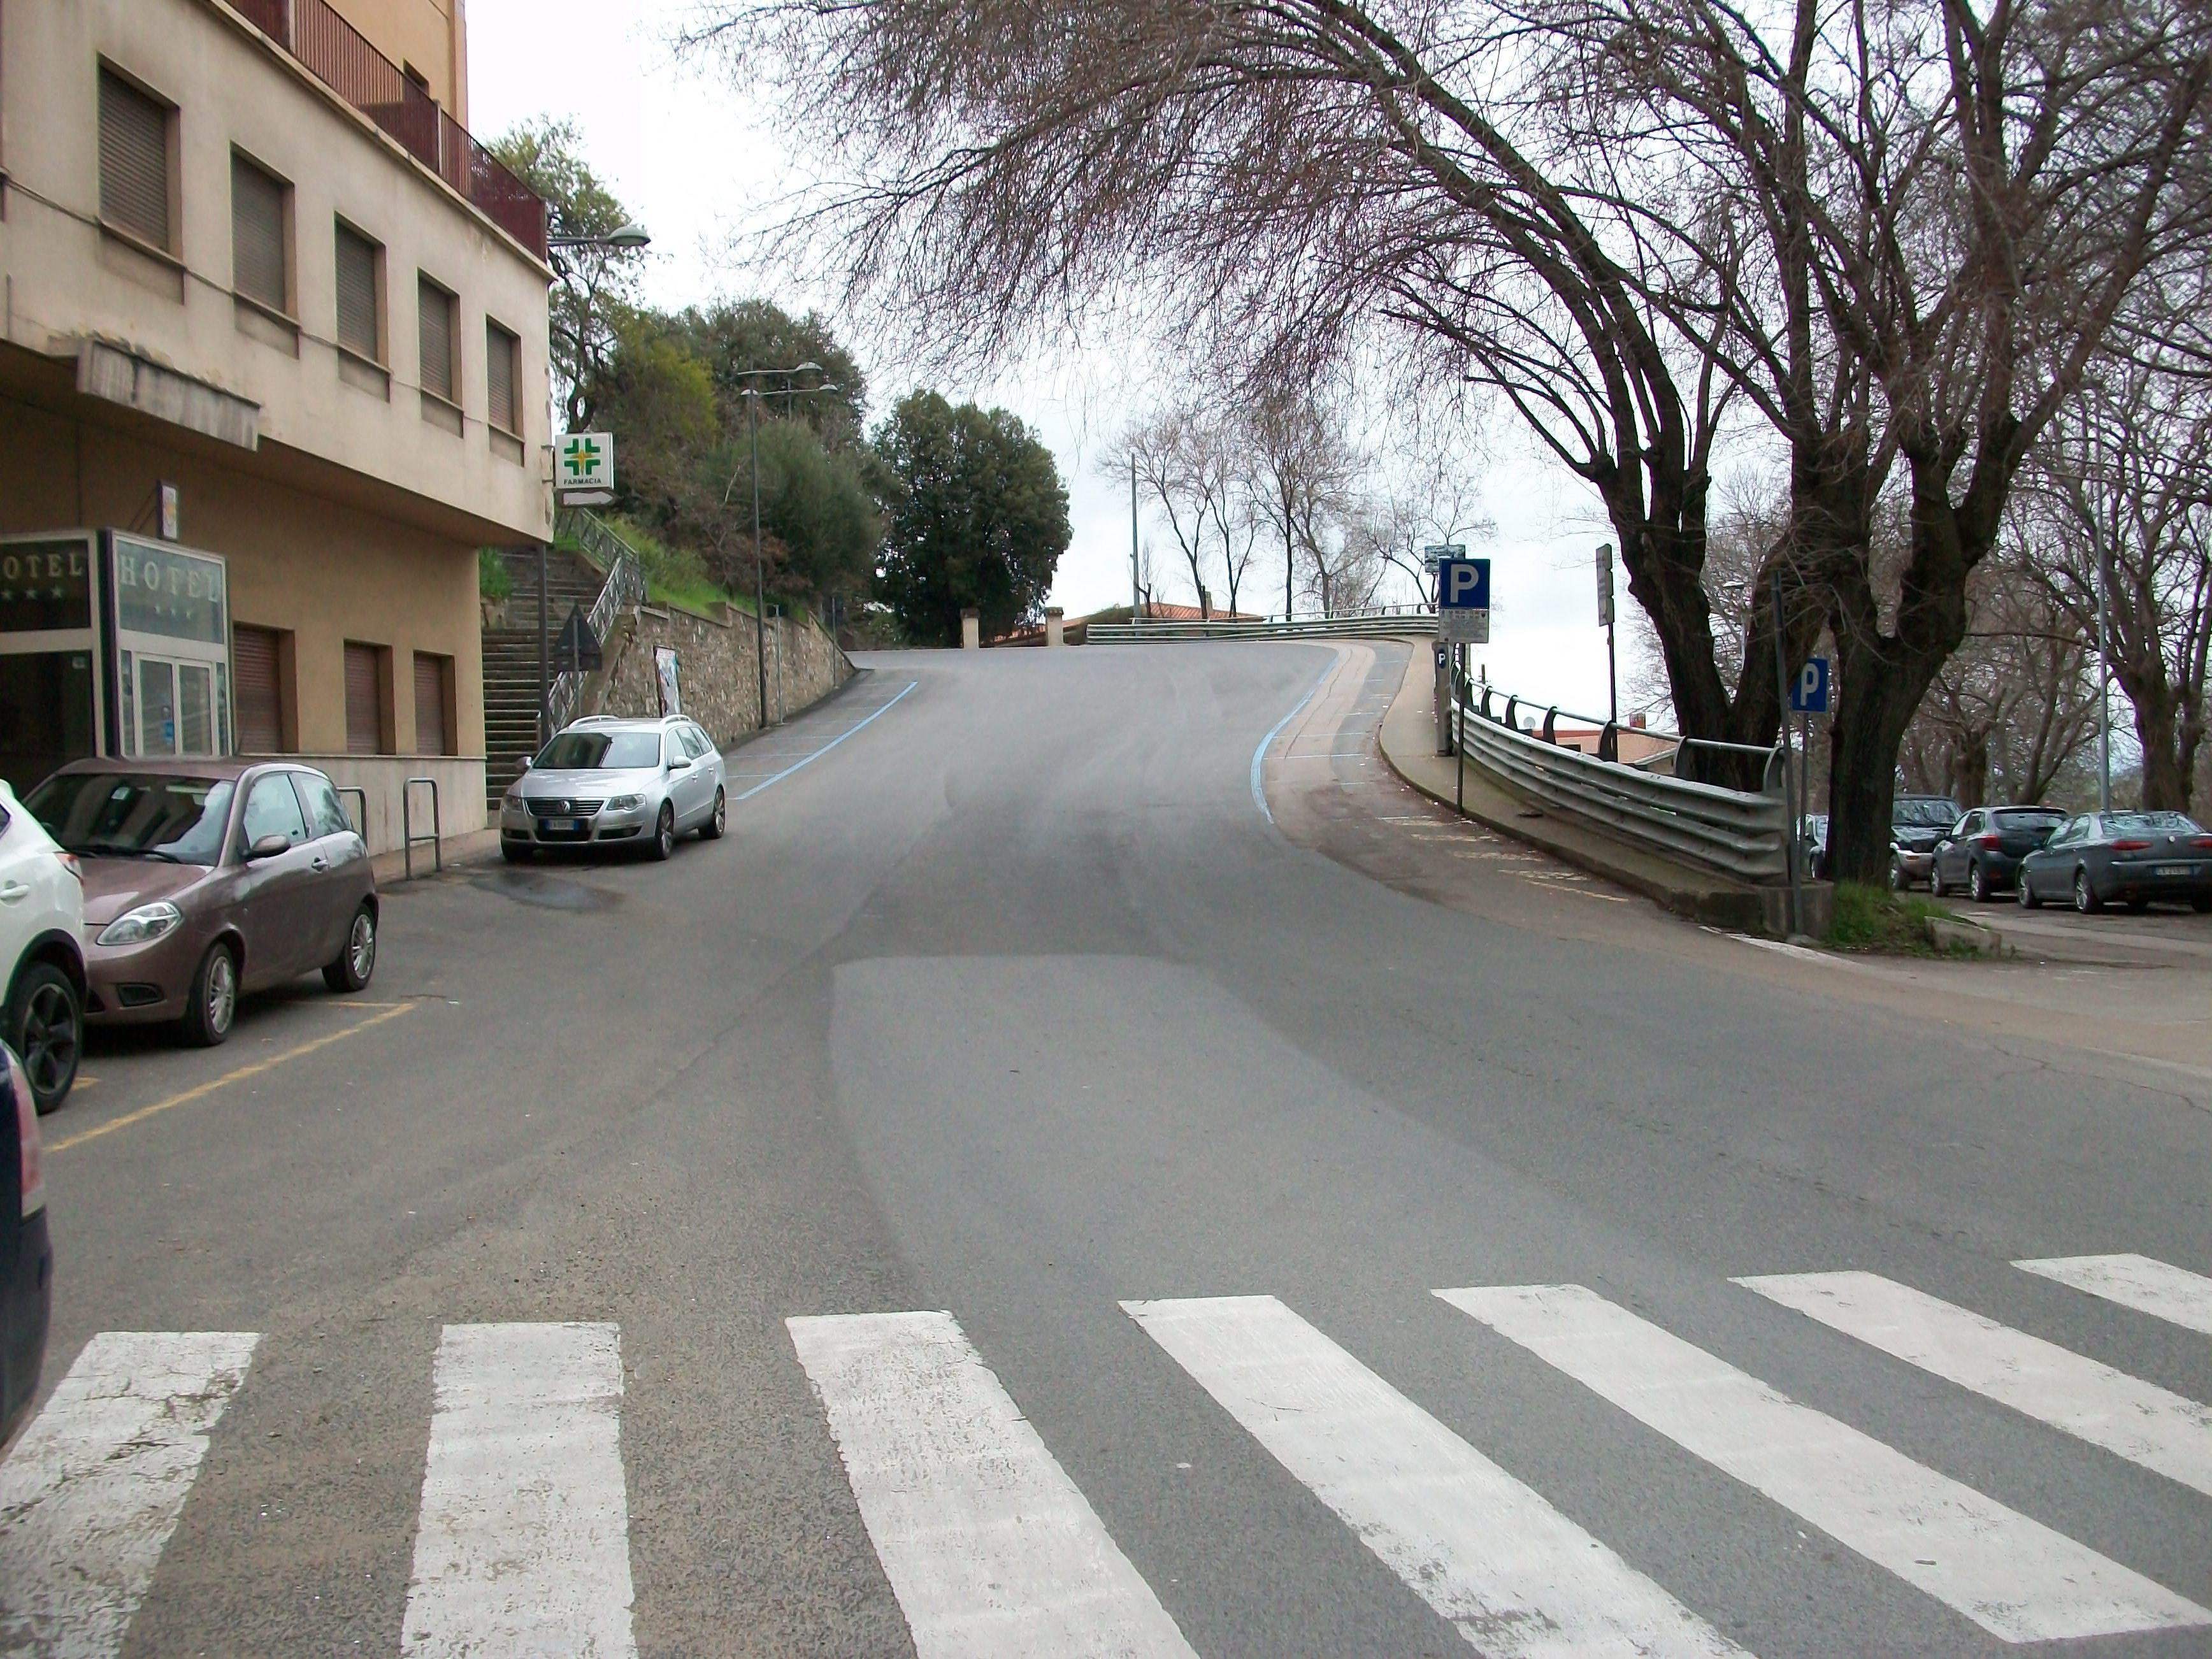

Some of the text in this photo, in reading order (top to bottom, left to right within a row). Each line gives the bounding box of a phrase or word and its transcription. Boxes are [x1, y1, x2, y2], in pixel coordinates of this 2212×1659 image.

[2, 552, 82, 580] OTEL
[119, 554, 219, 603] HOTEL
[1449, 564, 1479, 603] P
[1438, 653, 1446, 664] P
[1800, 663, 1820, 707] P
